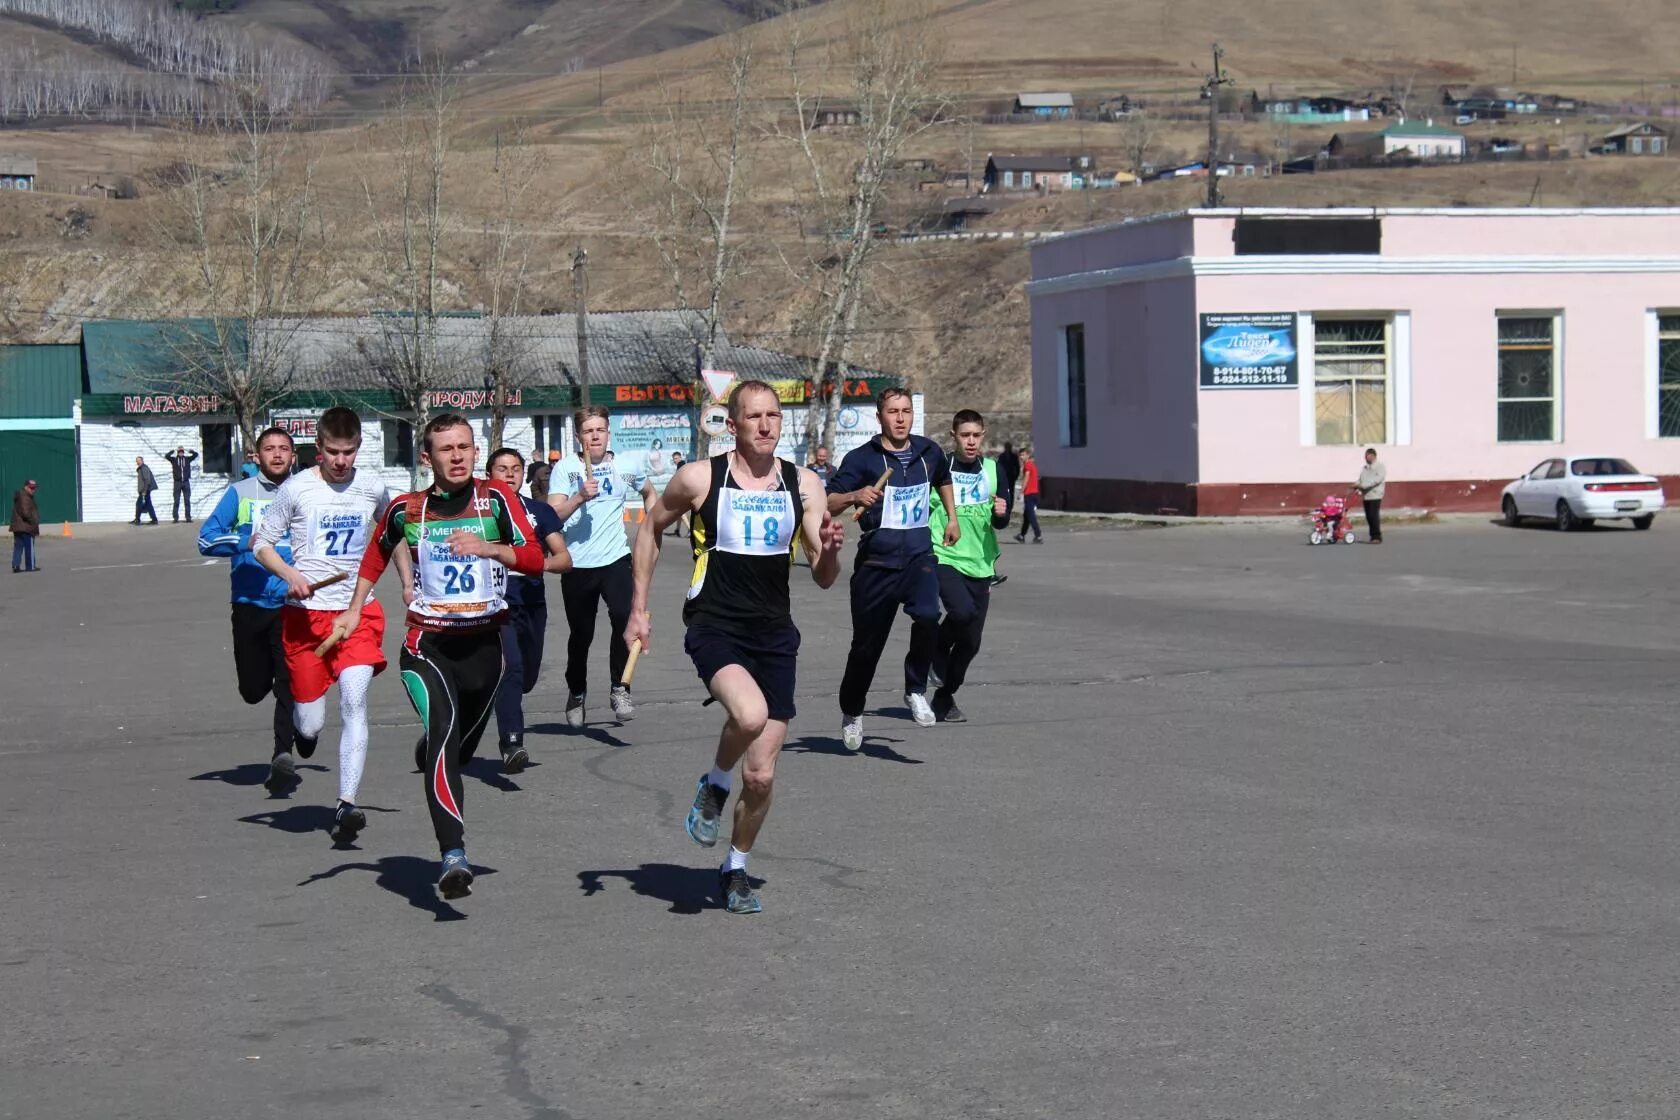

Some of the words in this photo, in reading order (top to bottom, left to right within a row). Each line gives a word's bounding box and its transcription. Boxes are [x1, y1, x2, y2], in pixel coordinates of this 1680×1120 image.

[429, 390, 521, 409] ПРОДУКЫ
[273, 419, 319, 436] ЕЛЕ
[473, 498, 490, 510] 333
[901, 500, 922, 525] 16
[432, 525, 485, 537] МЕГФОН
[743, 516, 779, 546] 18
[325, 529, 355, 556] 27
[443, 564, 475, 595] 26
